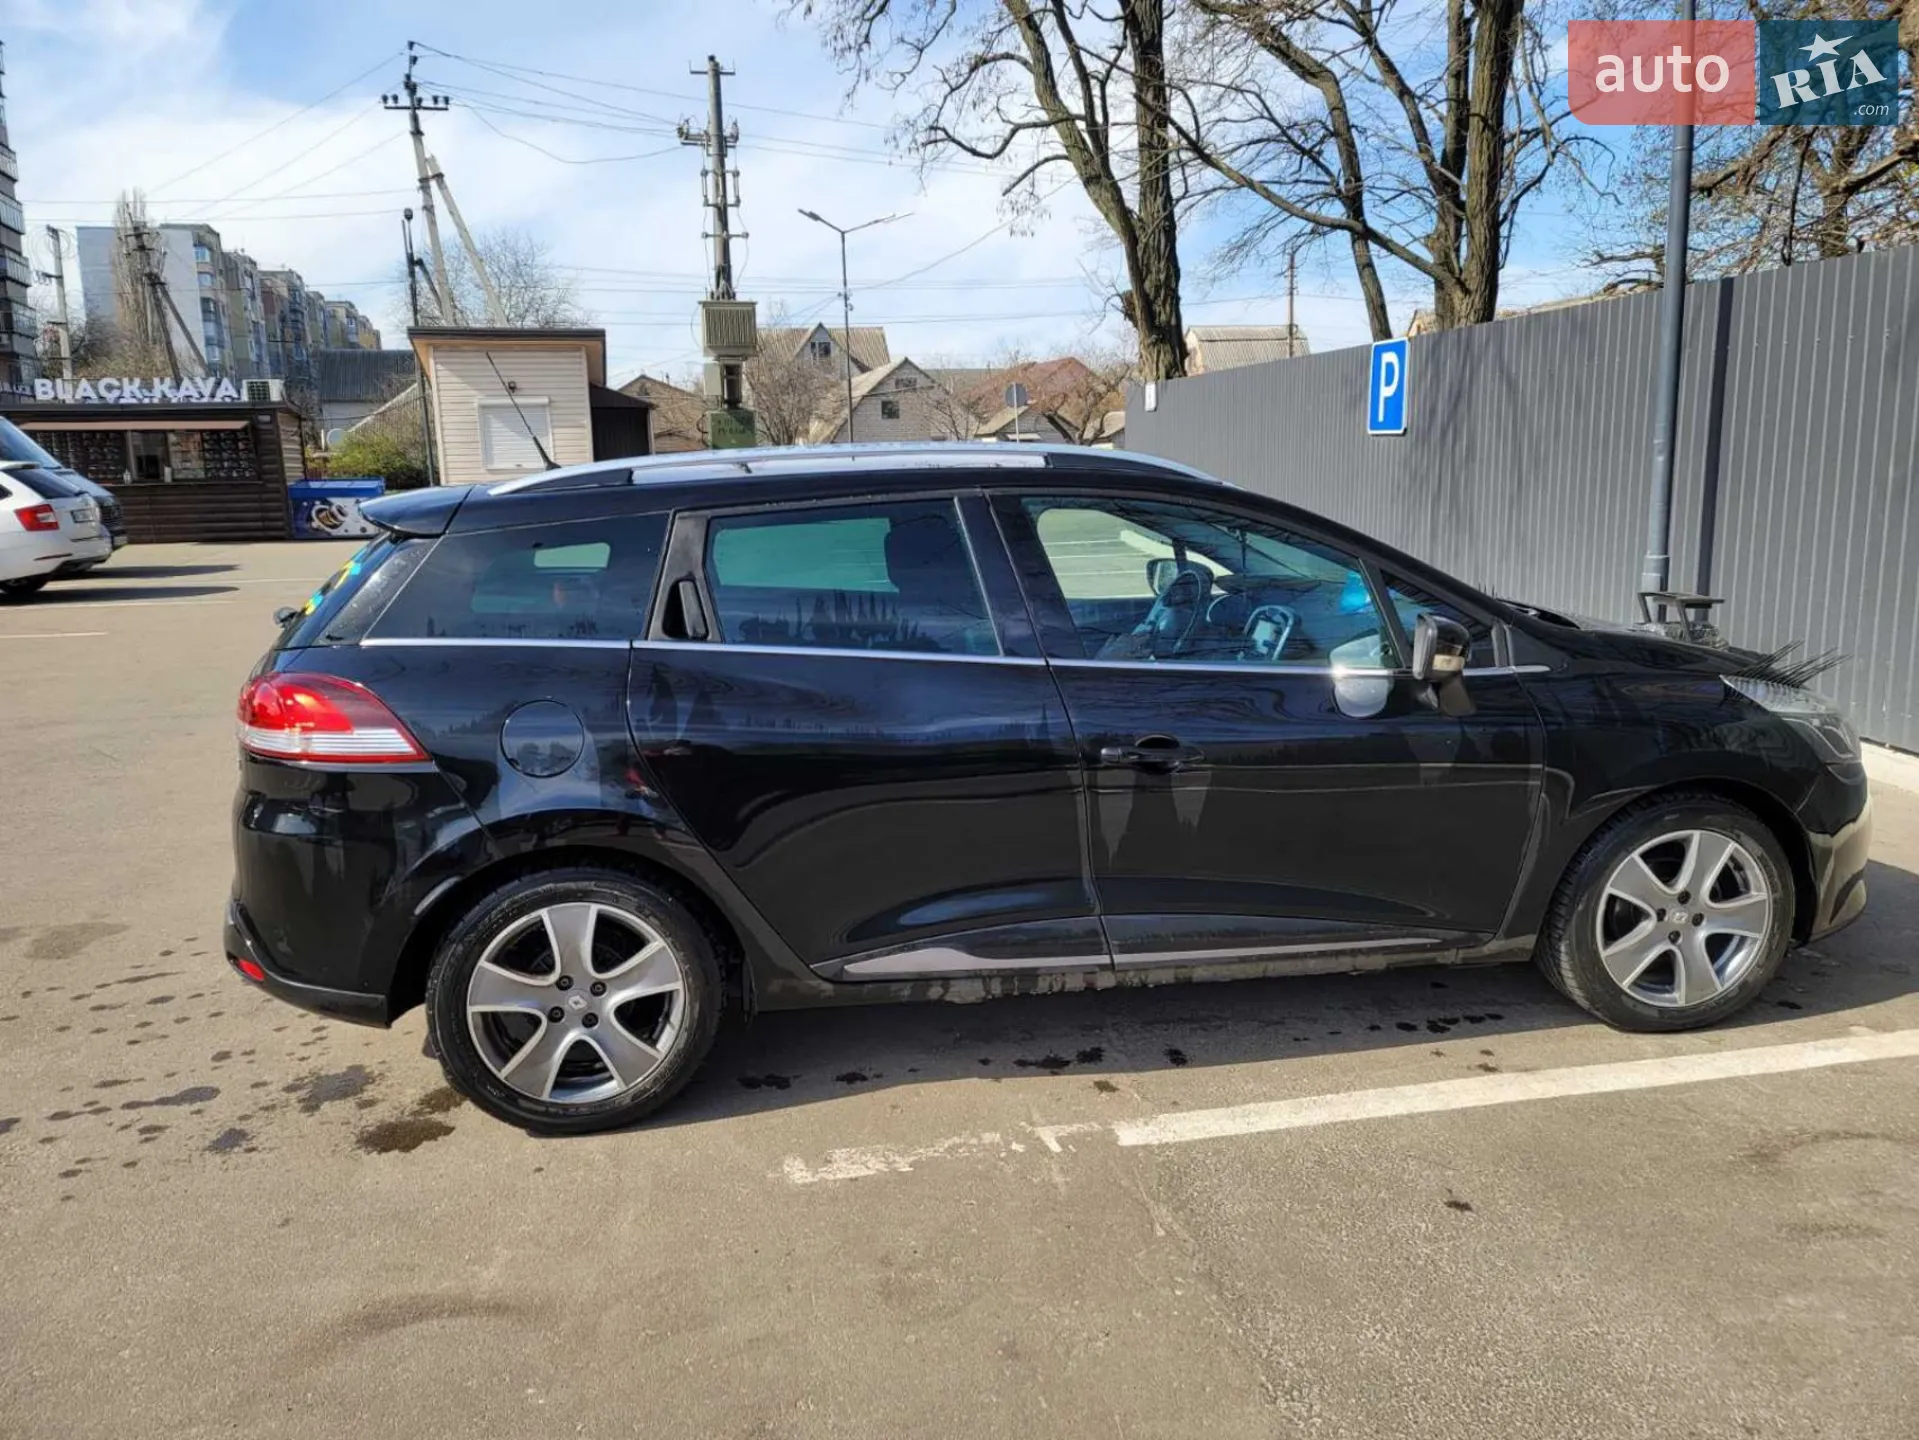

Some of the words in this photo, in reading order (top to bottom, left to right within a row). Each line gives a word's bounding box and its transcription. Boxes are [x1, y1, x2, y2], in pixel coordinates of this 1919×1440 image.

[34, 377, 144, 400] BLACK
[152, 376, 240, 399] KAVA
[1378, 351, 1400, 422] P
